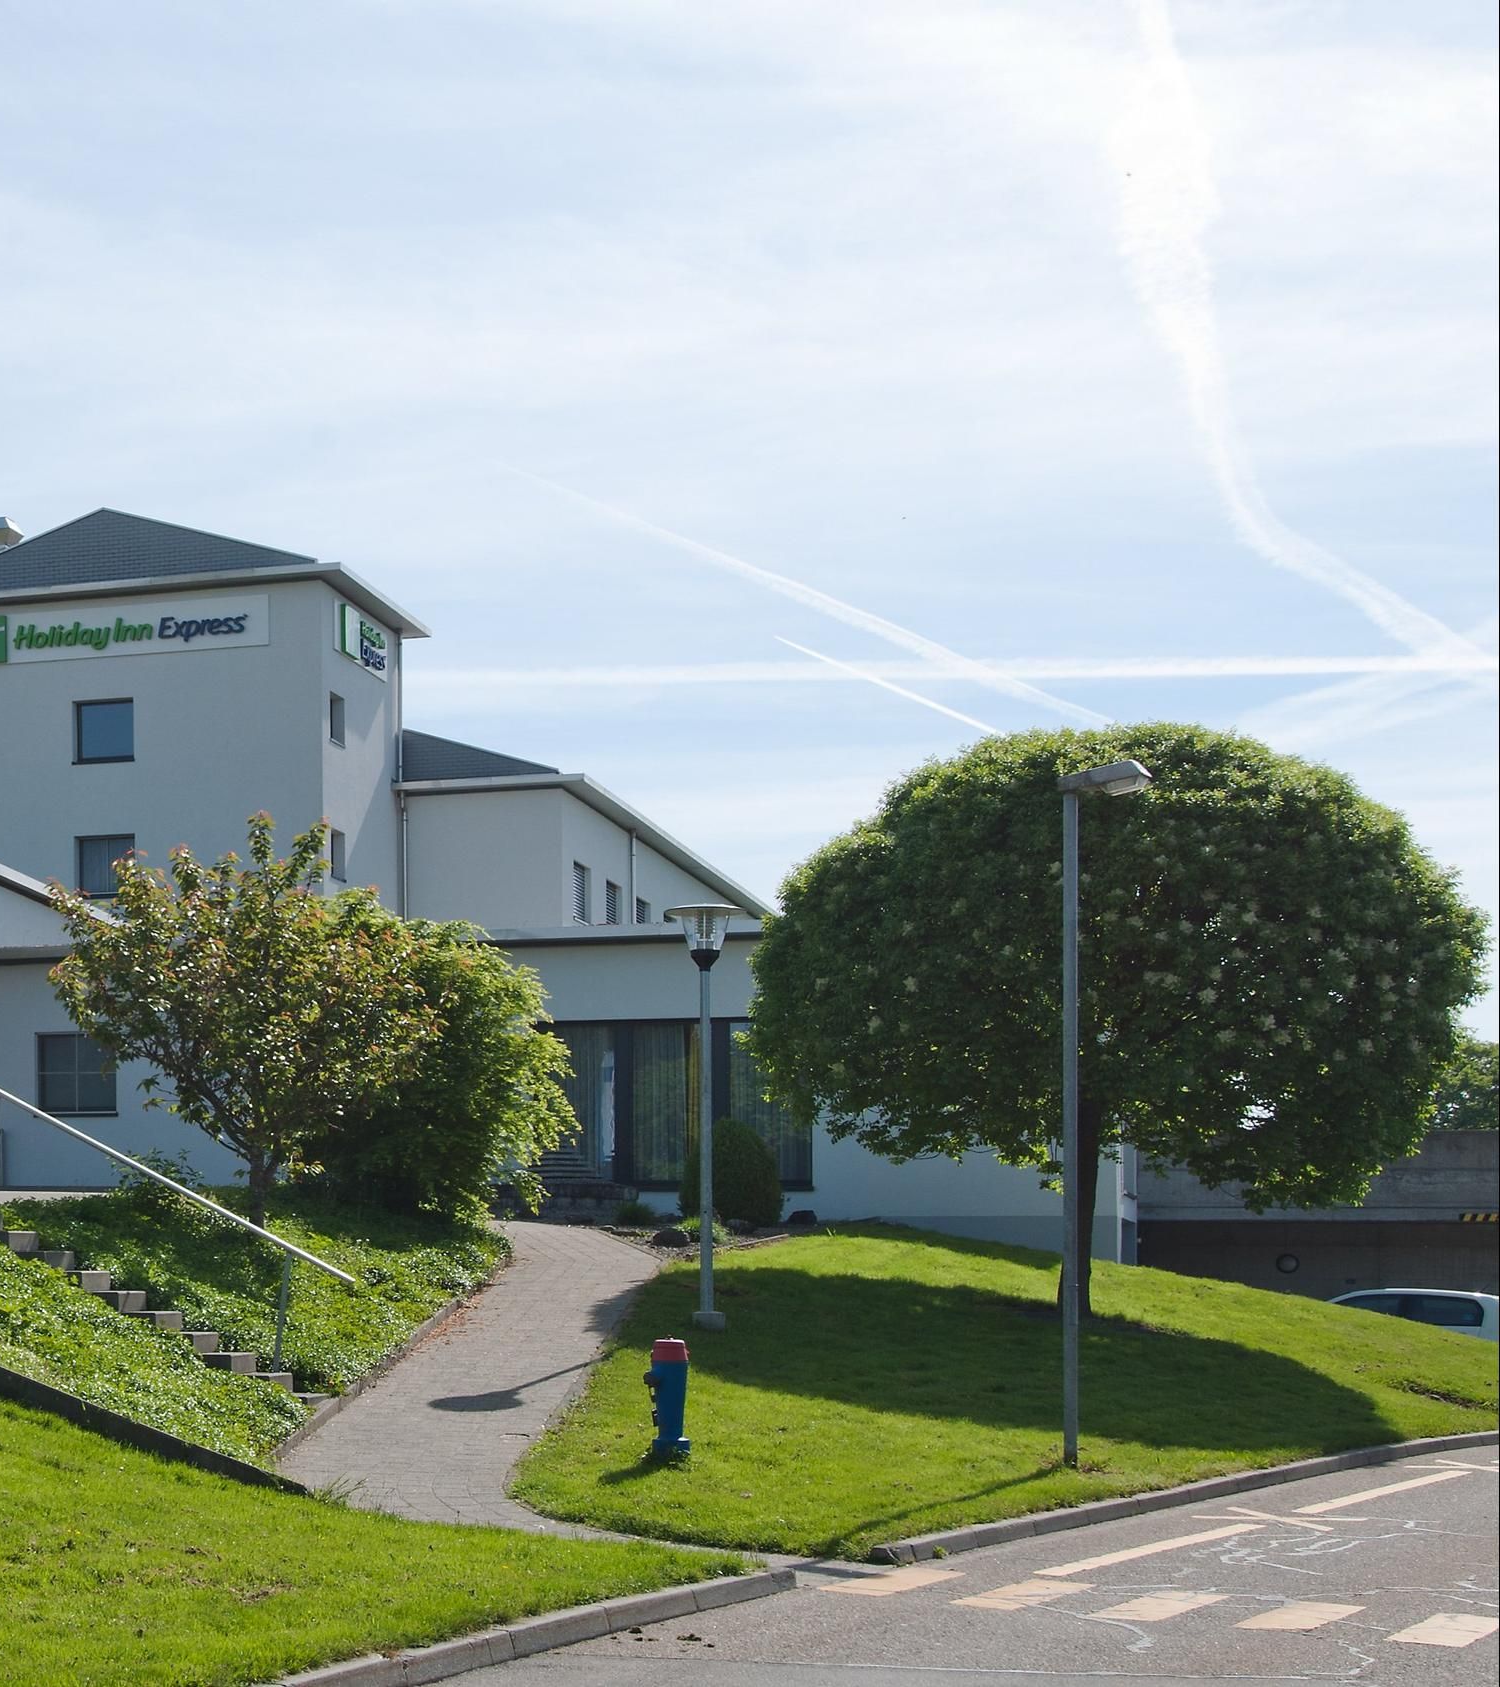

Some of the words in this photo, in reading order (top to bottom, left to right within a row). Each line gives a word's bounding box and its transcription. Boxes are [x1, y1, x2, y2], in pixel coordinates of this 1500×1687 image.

[13, 621, 110, 650] Holiday
[114, 617, 153, 642] Inn
[157, 614, 248, 642] Express
